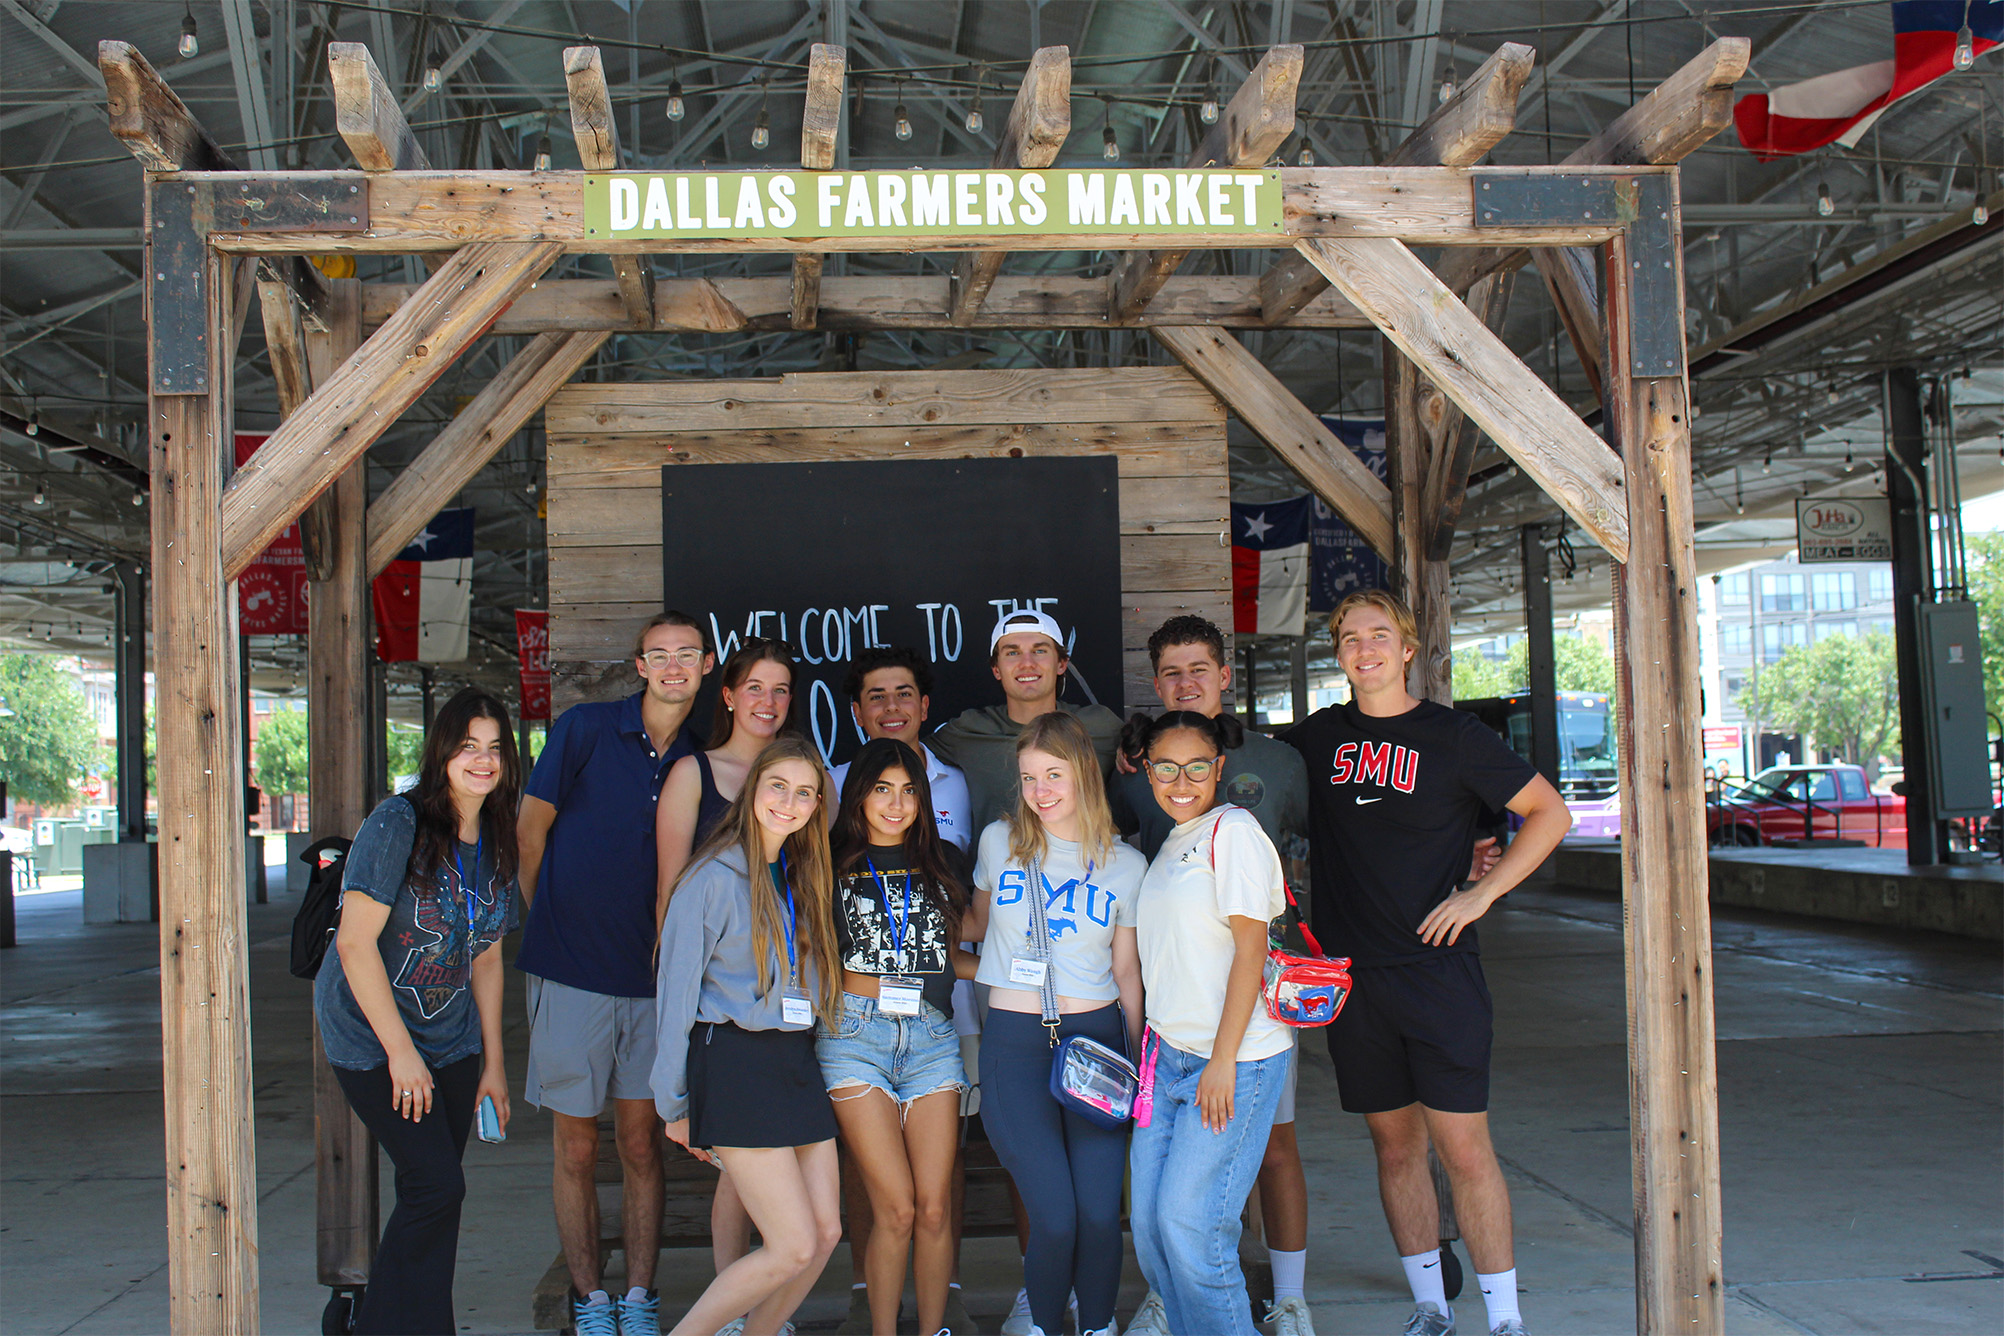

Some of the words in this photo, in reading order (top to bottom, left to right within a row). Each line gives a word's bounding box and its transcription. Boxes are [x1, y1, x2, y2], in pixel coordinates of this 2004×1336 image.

[609, 175, 797, 230] DALLAS
[818, 173, 1046, 228] FARMERS
[1067, 173, 1264, 226] MARKET
[1804, 547, 1840, 559] MEAT
[1854, 546, 1890, 558] EGGS
[709, 604, 891, 665] WELCOME
[916, 602, 964, 663] TO
[1330, 741, 1420, 794] SMU
[935, 817, 953, 826] SMU
[996, 869, 1117, 928] SMU
